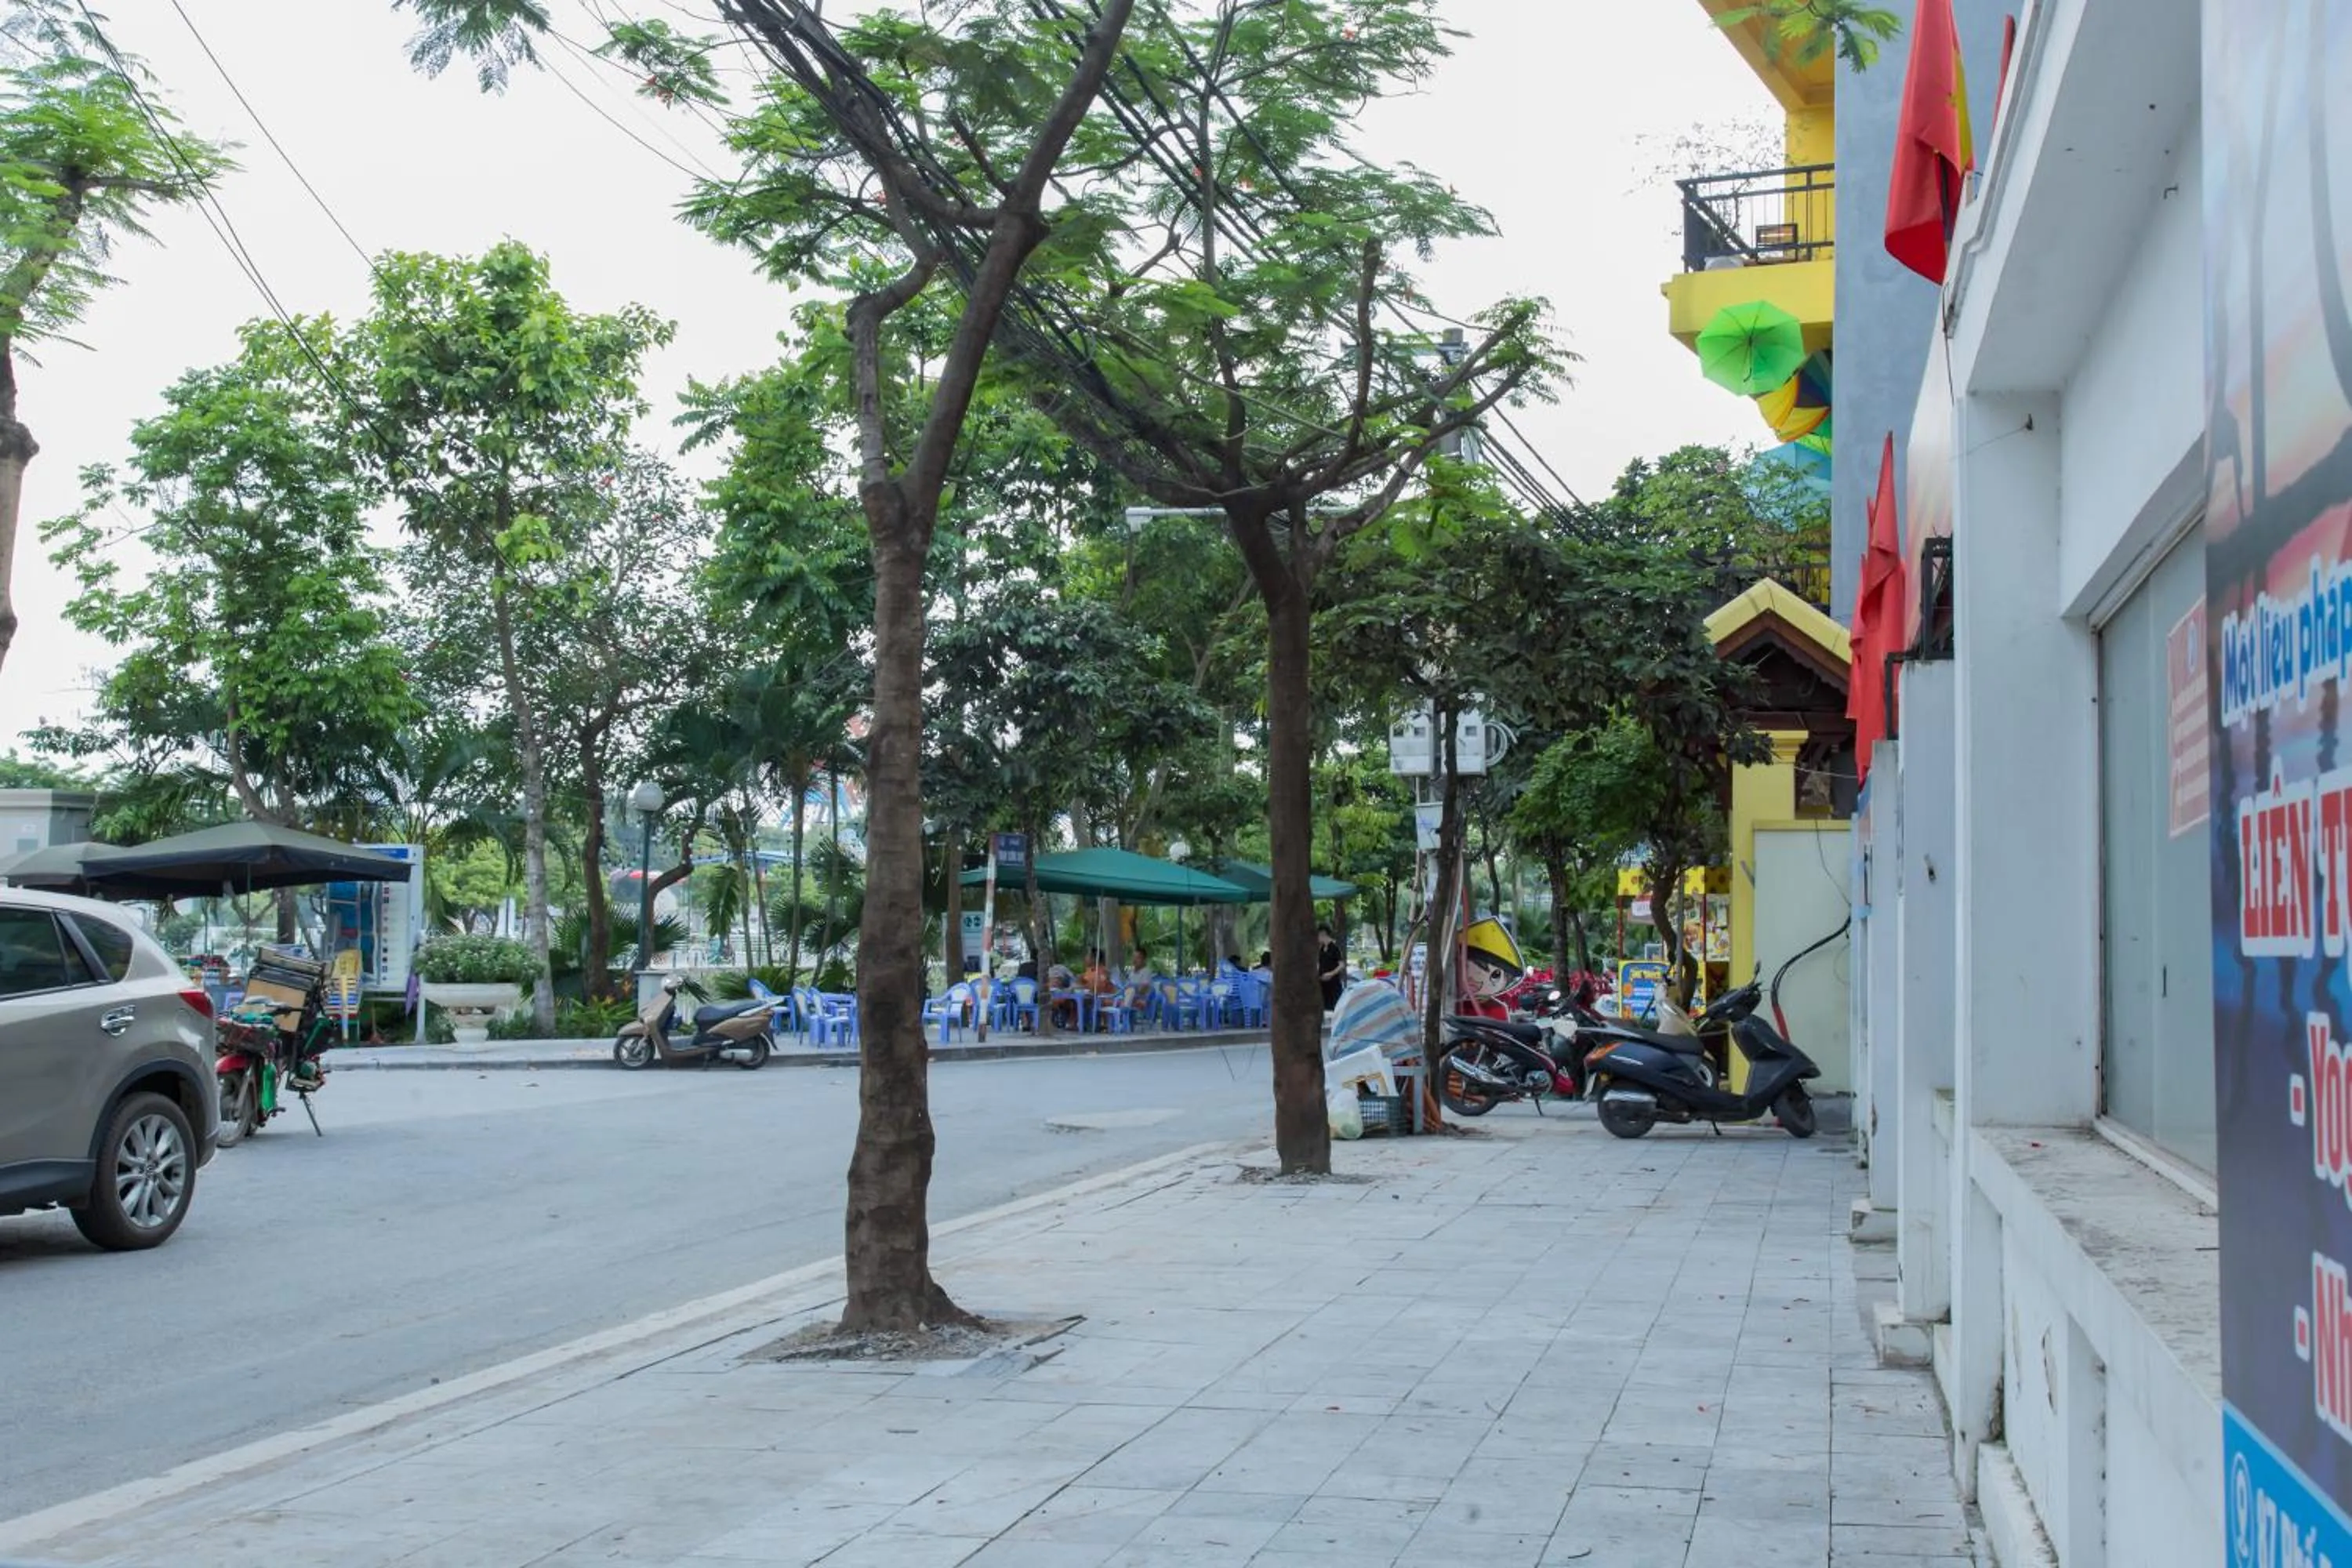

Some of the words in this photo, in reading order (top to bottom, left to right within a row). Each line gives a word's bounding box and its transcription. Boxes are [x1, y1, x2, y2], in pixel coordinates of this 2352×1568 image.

[2223, 613, 2257, 721] Một
[2259, 602, 2294, 705] liệu
[2298, 568, 2352, 701] pháp
[2241, 772, 2312, 939] LIÊN
[2280, 1508, 2317, 1568] Ph
